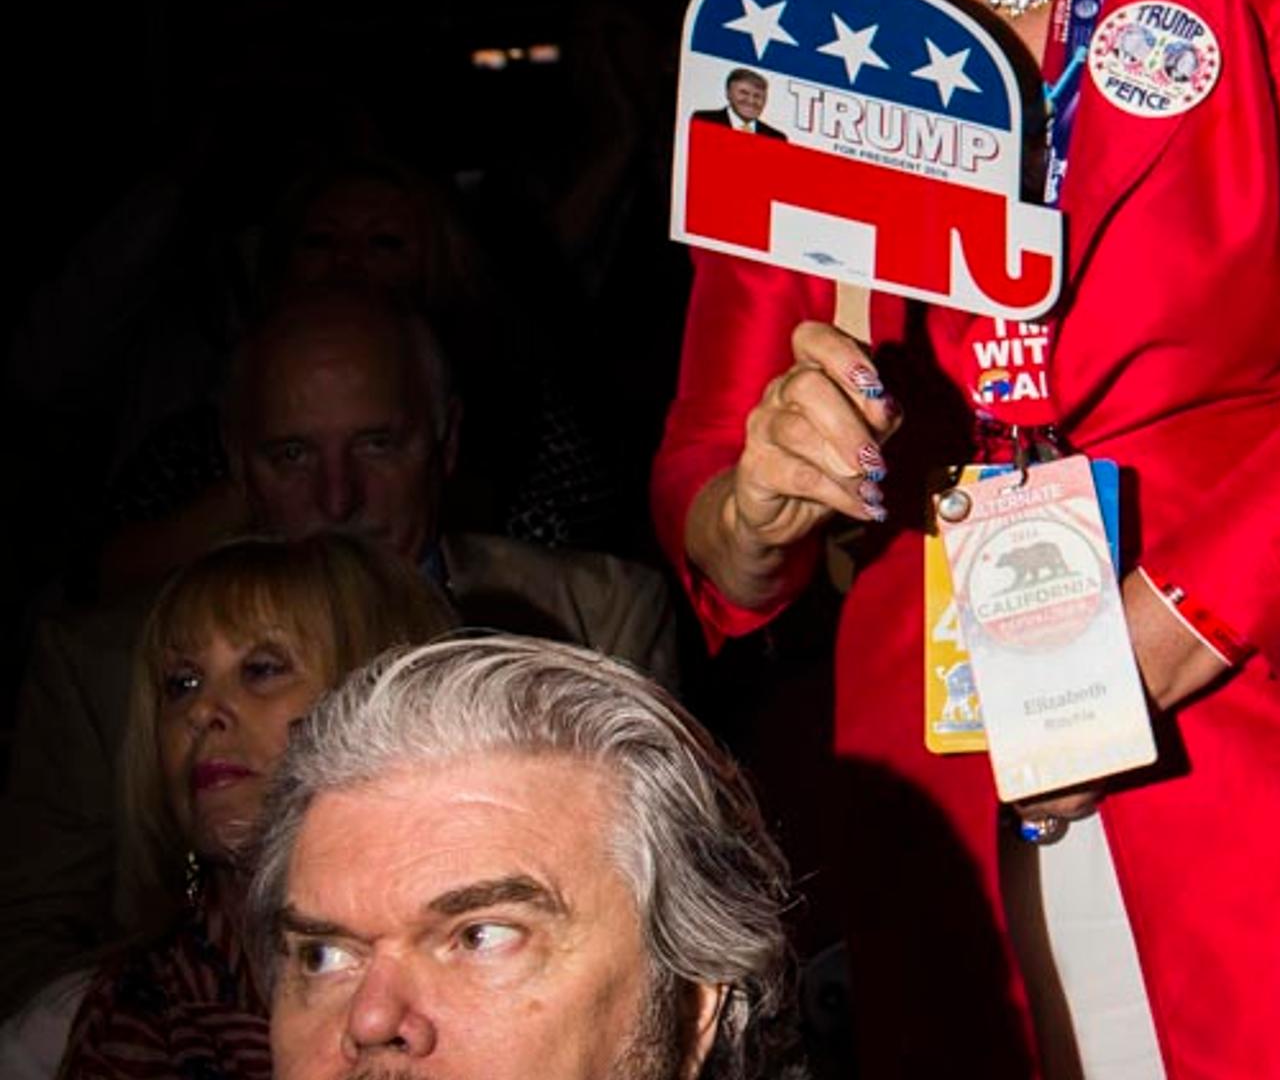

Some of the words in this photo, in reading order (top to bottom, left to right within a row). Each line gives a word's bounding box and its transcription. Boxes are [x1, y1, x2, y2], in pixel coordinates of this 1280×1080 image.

[1137, 4, 1206, 40] TRUMP
[1104, 76, 1172, 111] PENCE
[785, 79, 1001, 173] TRUMP
[859, 148, 922, 171] PRESIDENT
[977, 577, 1099, 618] CALIFORNIA
